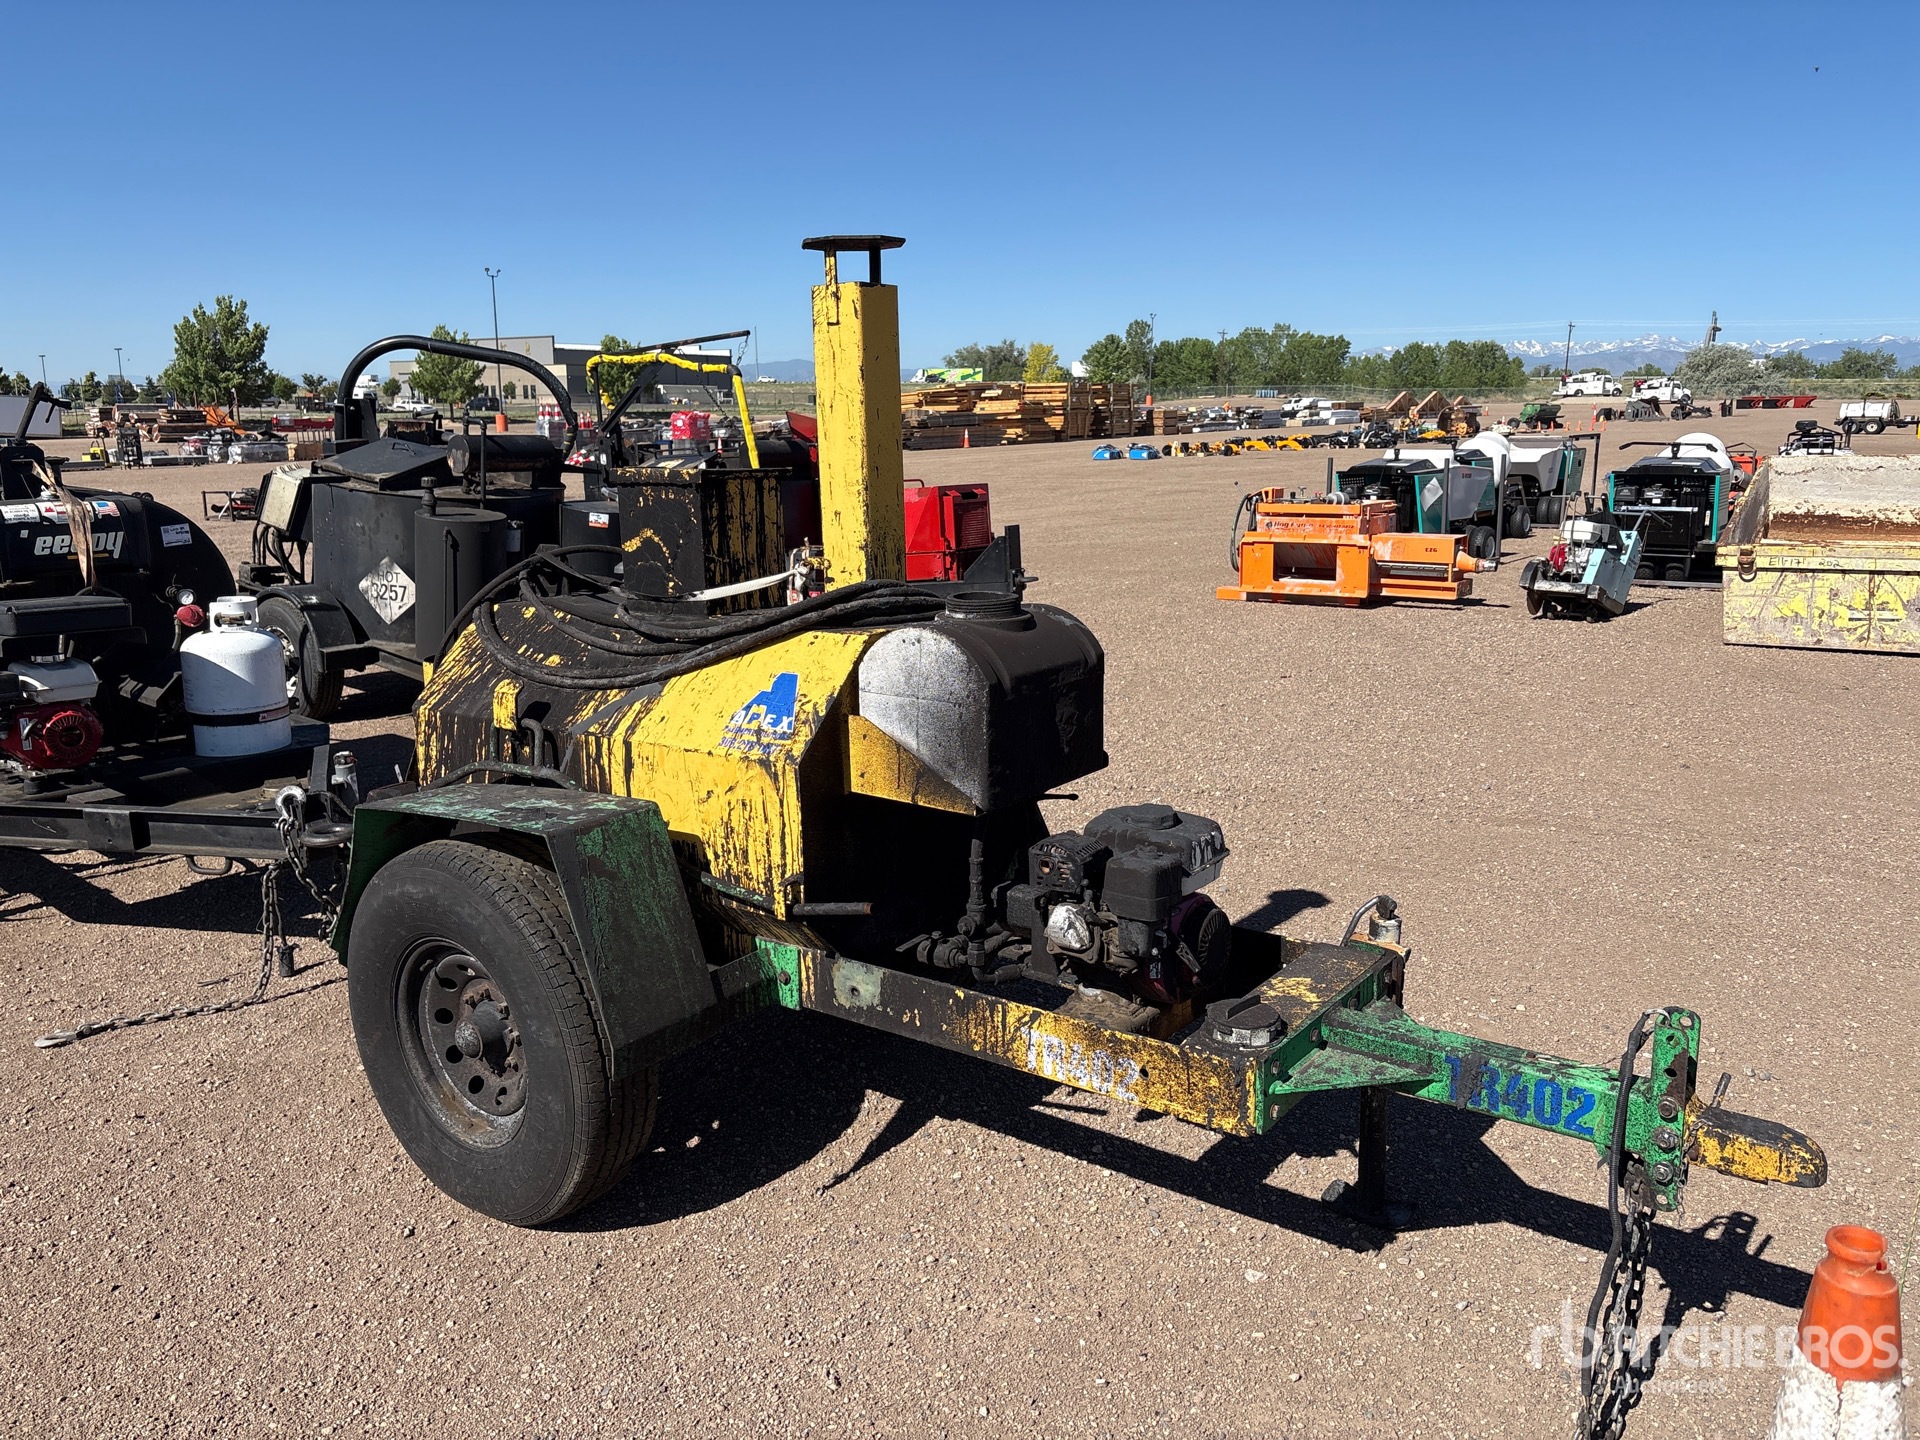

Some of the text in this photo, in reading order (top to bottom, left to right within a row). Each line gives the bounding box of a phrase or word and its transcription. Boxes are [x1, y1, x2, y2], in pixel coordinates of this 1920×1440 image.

[378, 570, 401, 583] HOT
[371, 583, 408, 602] 3257
[729, 703, 794, 732] APEX
